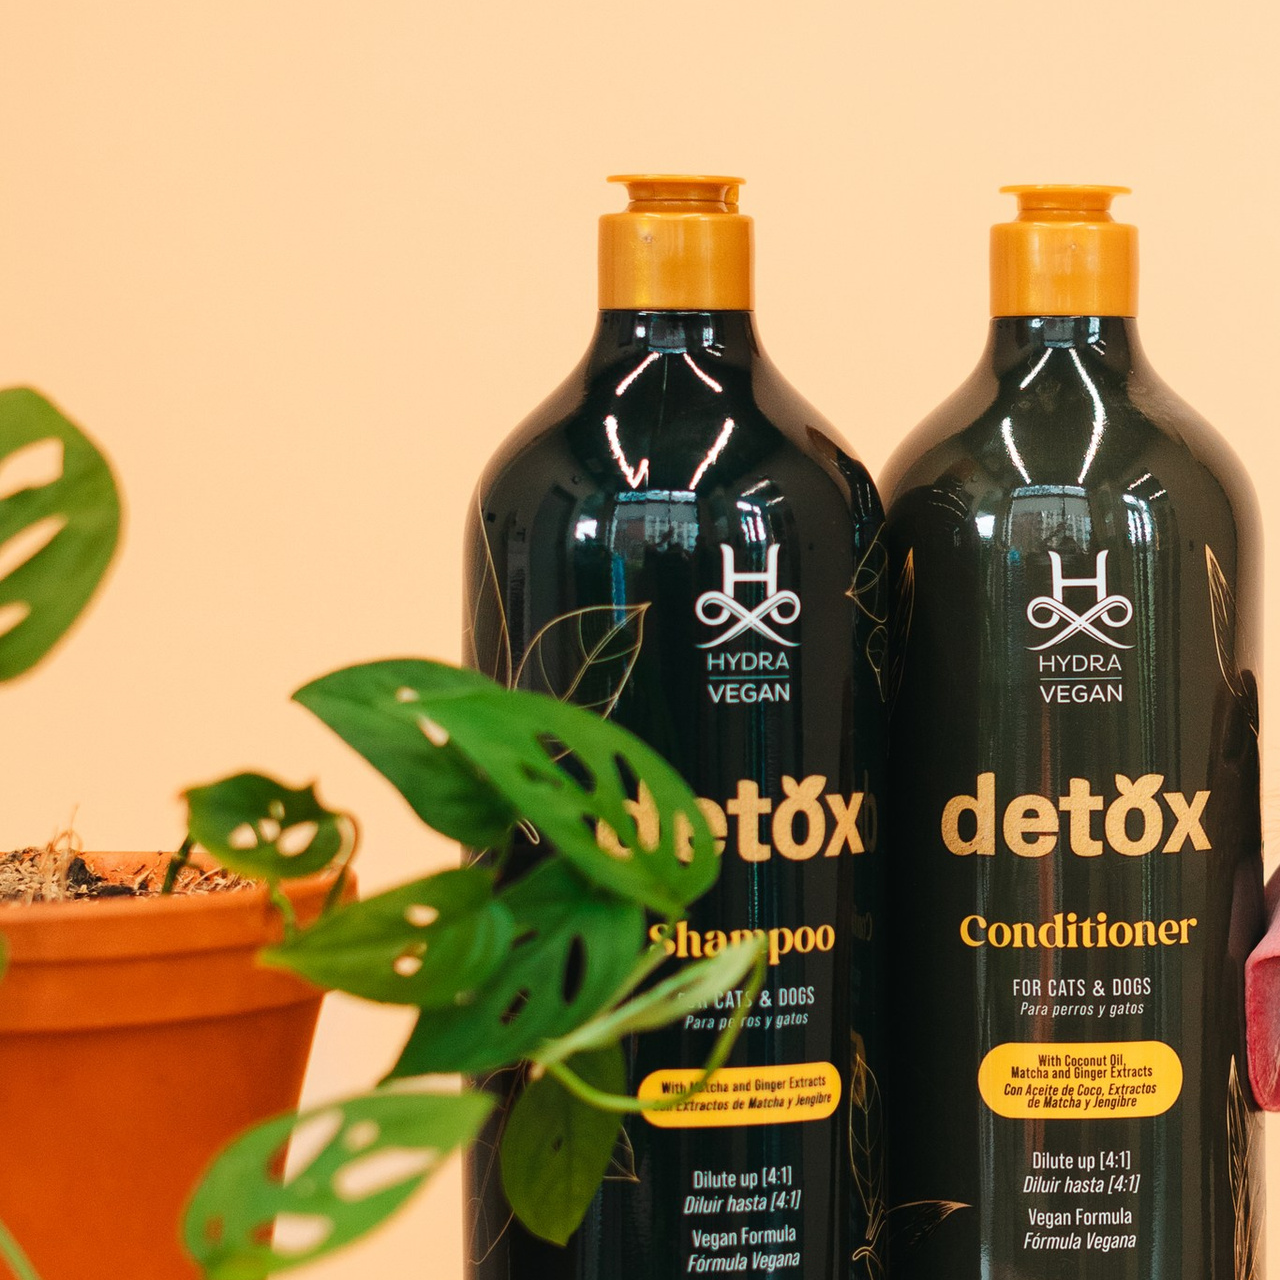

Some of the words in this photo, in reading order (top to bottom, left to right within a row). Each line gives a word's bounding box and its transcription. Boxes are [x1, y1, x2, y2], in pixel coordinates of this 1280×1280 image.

[707, 651, 790, 671] HYDRA
[1039, 654, 1122, 673] HYDRA
[707, 683, 791, 704] VEGAN
[1040, 684, 1123, 704] VEGAN
[941, 771, 1212, 857] detox
[960, 911, 1198, 949] Conditioner
[759, 989, 772, 1008] &
[778, 986, 815, 1006] DOGS
[1012, 979, 1042, 997] FOR
[1048, 979, 1086, 997] CATS
[1092, 979, 1106, 997] &
[1112, 977, 1152, 996] DOGS
[1020, 1002, 1049, 1016] Para
[1052, 1003, 1094, 1018] perros
[1097, 1003, 1106, 1018] y
[1109, 1002, 1145, 1018] gatos
[684, 1015, 715, 1030] Para
[719, 1015, 762, 1031] peros
[764, 1015, 773, 1030] y
[775, 1012, 809, 1029] gatos
[1038, 1054, 1062, 1067] With
[1064, 1054, 1107, 1067] Coconut
[1110, 1053, 1127, 1068] Oil,
[1011, 1066, 1049, 1079] Matcha
[1052, 1066, 1071, 1079] and
[1074, 1066, 1107, 1081] Ginger
[1110, 1065, 1153, 1079] Extracts
[661, 1081, 687, 1094] With
[733, 1080, 752, 1092] and
[754, 1078, 786, 1093] Ginger
[789, 1075, 826, 1089] Extracts
[1004, 1083, 1023, 1096] Con
[1025, 1083, 1059, 1096] Aceite
[1061, 1083, 1075, 1096] de
[1077, 1083, 1105, 1098] Coco,
[1108, 1082, 1157, 1096] Extractos
[732, 1098, 745, 1109] de
[748, 1096, 785, 1109] Matcha
[786, 1097, 793, 1109] y
[795, 1092, 832, 1108] Jengibre
[1027, 1096, 1041, 1108] de
[1043, 1096, 1082, 1109] Matcha
[1083, 1098, 1092, 1111] y
[1093, 1094, 1138, 1110] Jengibre
[1032, 1151, 1074, 1170] Dilute
[1077, 1154, 1095, 1173] up
[1100, 1150, 1131, 1170] [4:1]
[692, 1170, 736, 1190] Dilute
[741, 1171, 759, 1190] up
[762, 1165, 793, 1187] [4:1]
[1023, 1175, 1062, 1193] Diluir
[1064, 1175, 1104, 1193] hasta
[1107, 1174, 1141, 1194] [4:1]
[683, 1195, 724, 1215] Diluir
[727, 1193, 767, 1212] hasta
[770, 1189, 802, 1212] [4:1]
[1028, 1208, 1072, 1229] Vegan
[1075, 1207, 1132, 1226] Formula
[692, 1229, 737, 1251] Vegan
[741, 1224, 797, 1246] Formula
[1023, 1232, 1081, 1250] Fórmula
[1086, 1233, 1137, 1253] Vegana
[687, 1252, 748, 1273] Fórmula
[751, 1251, 801, 1272] Vegana
